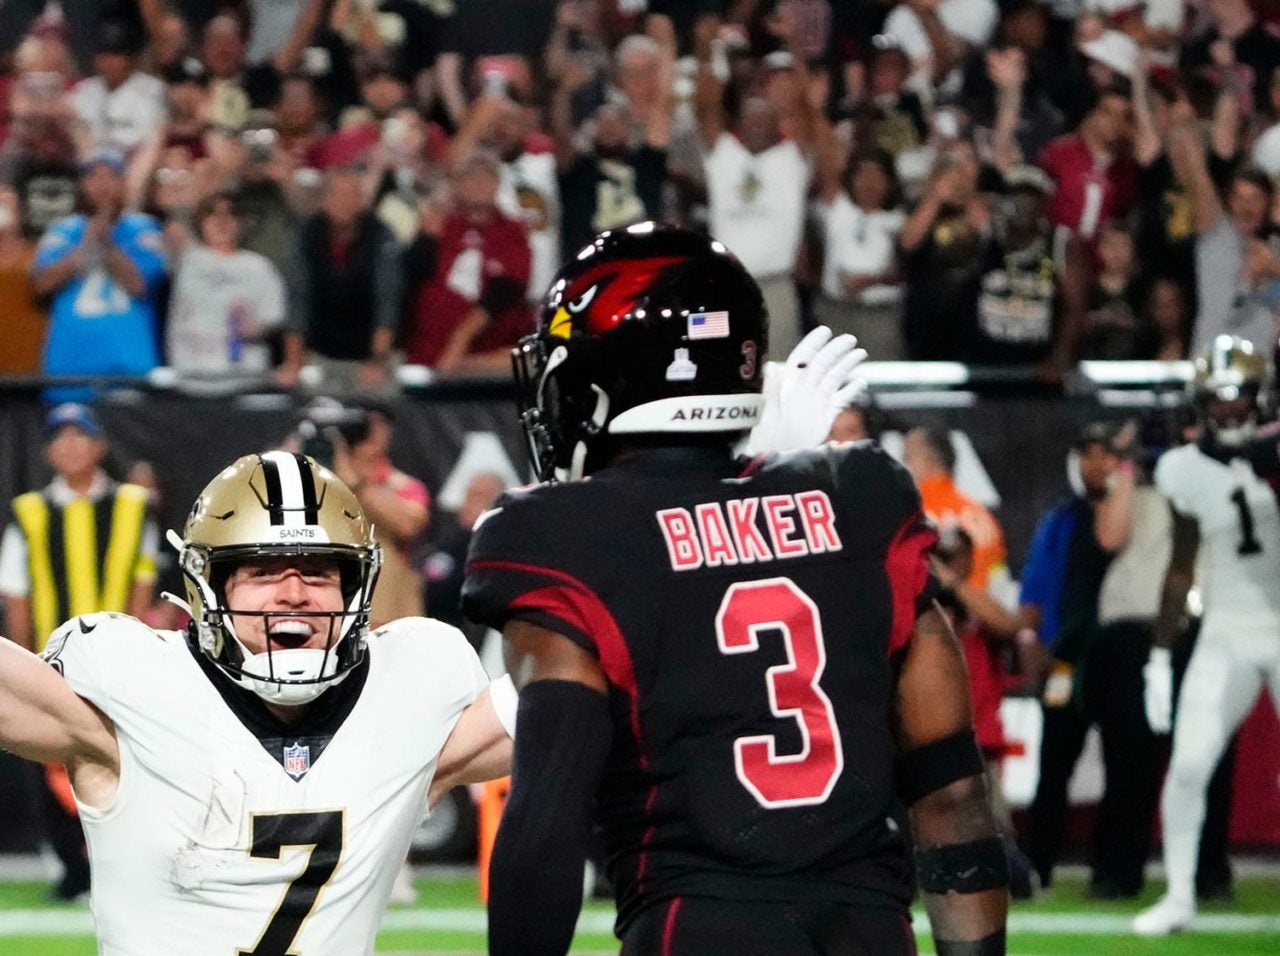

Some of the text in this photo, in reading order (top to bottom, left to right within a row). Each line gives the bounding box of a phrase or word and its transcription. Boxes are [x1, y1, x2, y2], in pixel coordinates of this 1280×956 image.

[740, 340, 757, 379] 3
[280, 529, 315, 538] SAINTS
[656, 490, 843, 571] BAKER
[1228, 485, 1265, 557] 1
[715, 576, 844, 809] 3
[288, 758, 306, 771] NFL
